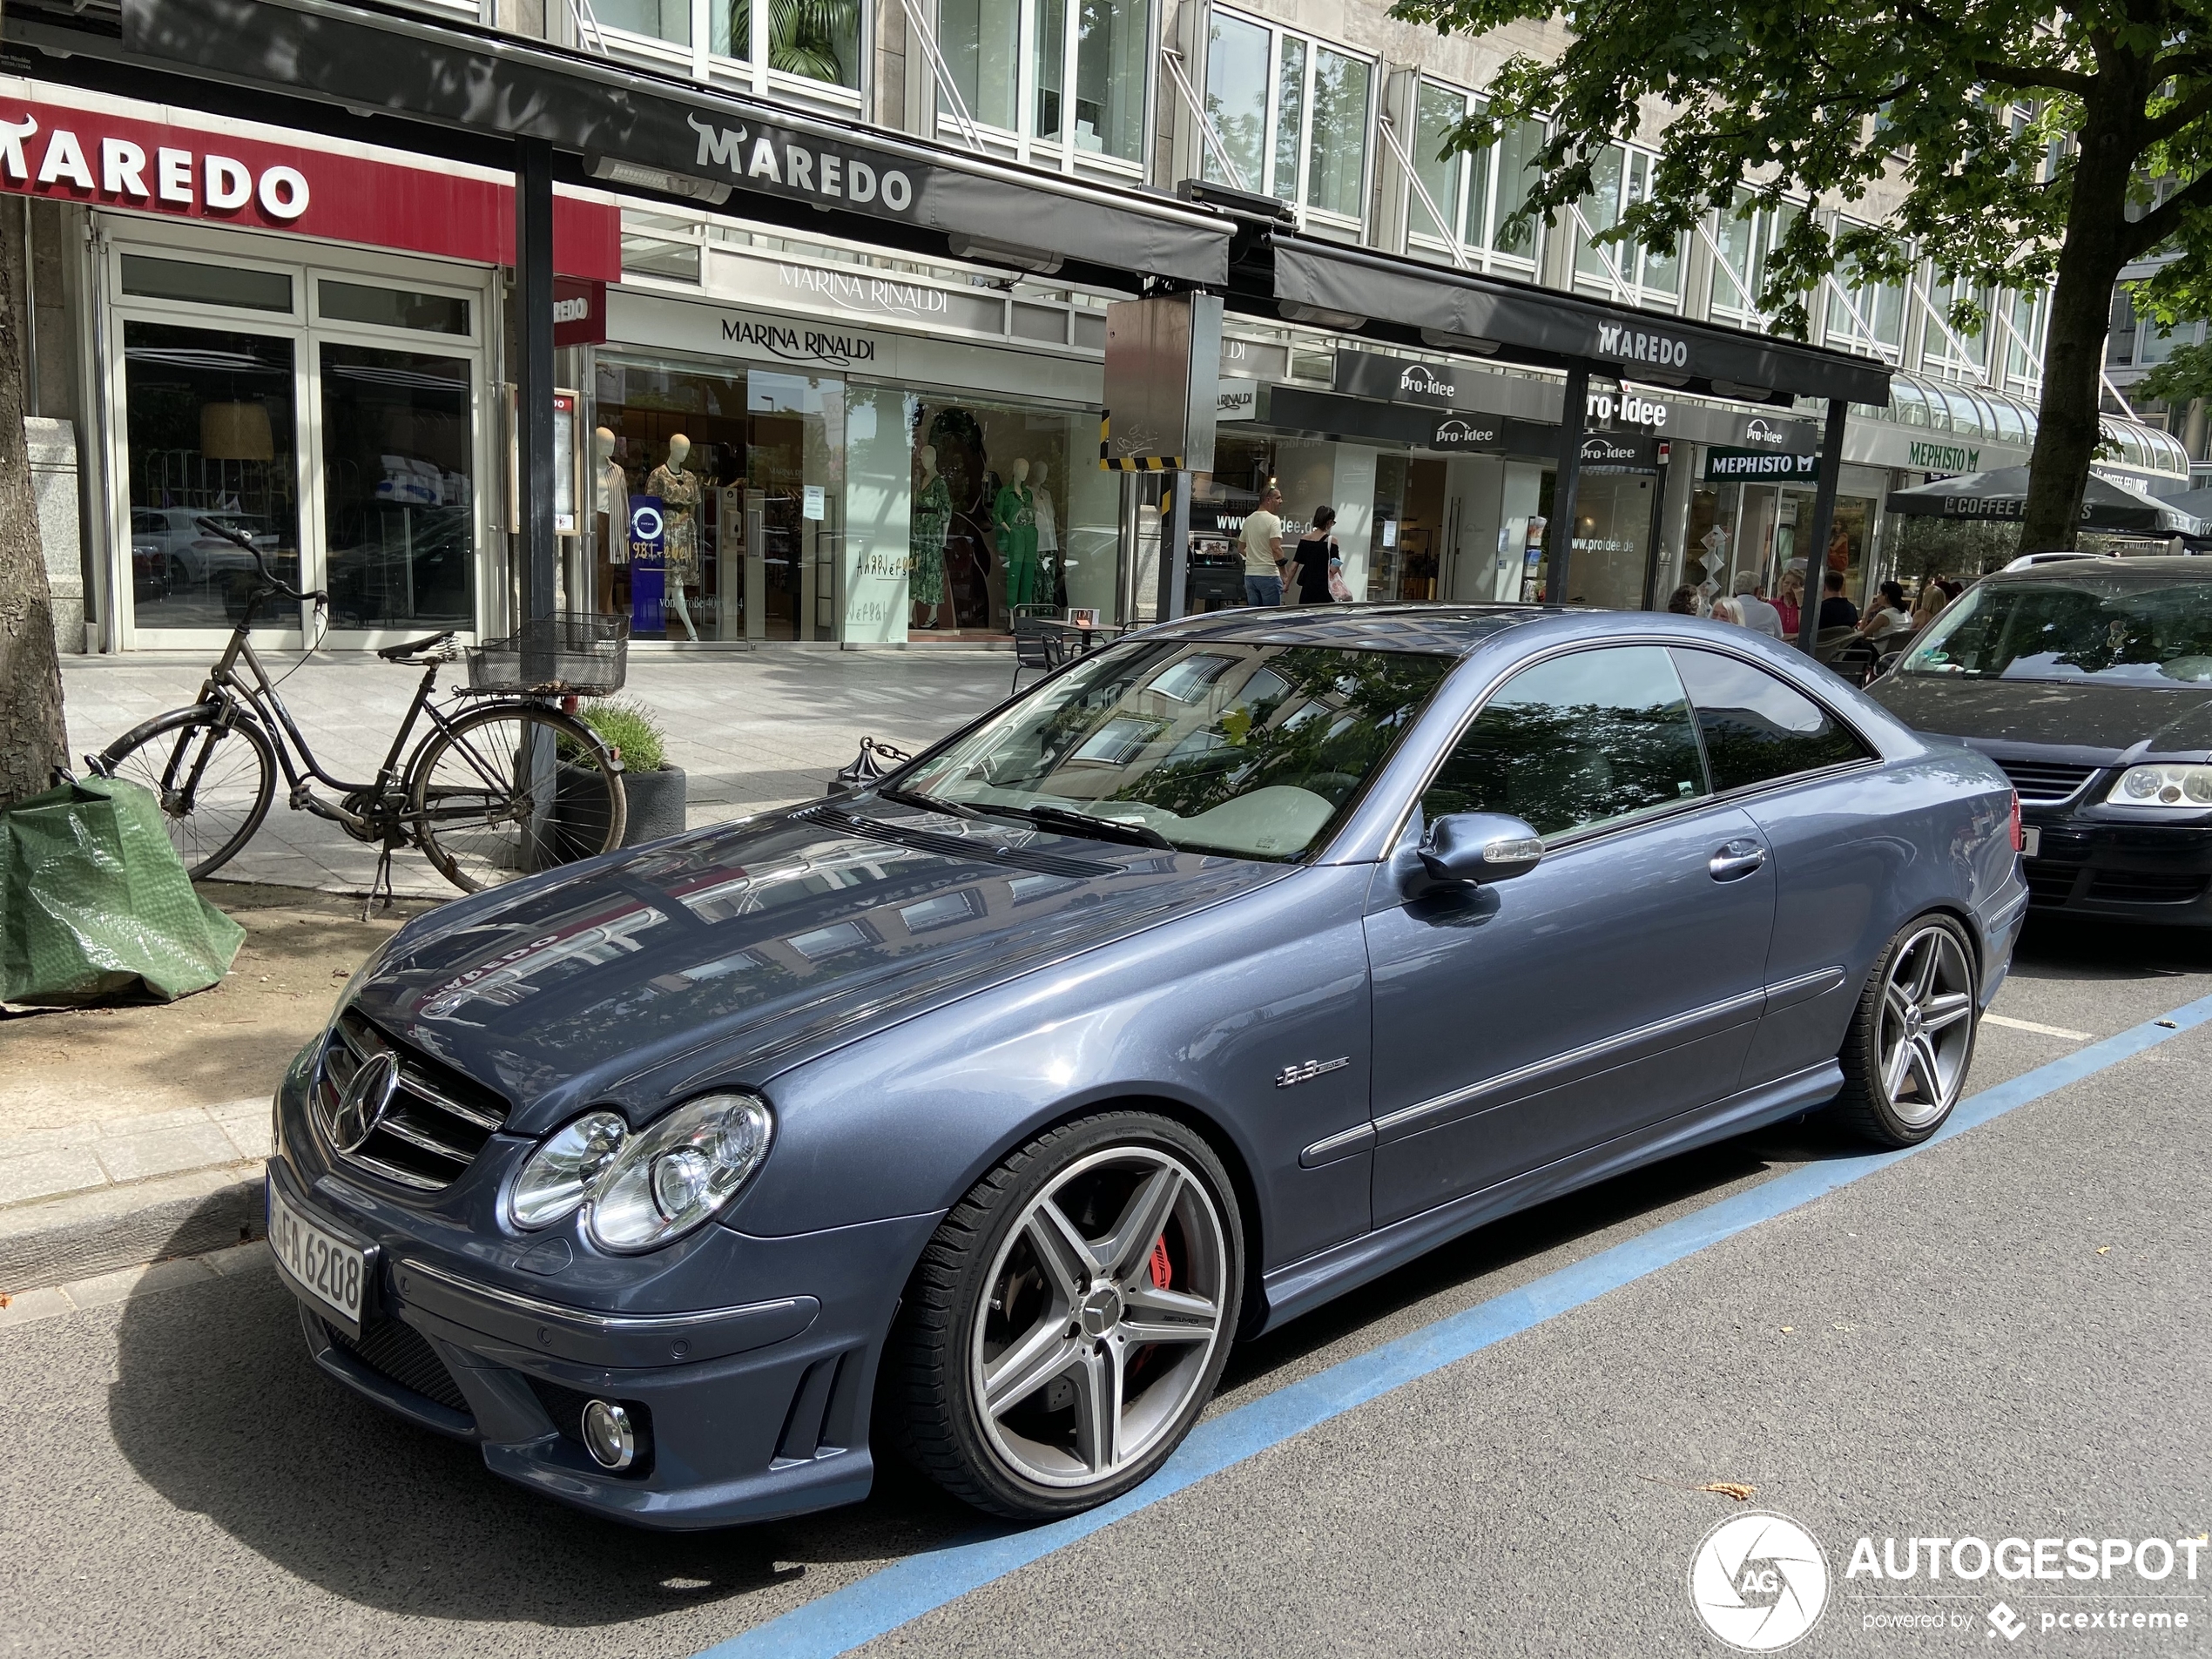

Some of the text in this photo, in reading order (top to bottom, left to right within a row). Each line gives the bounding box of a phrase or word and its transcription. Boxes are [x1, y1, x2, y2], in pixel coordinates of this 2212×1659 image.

[687, 111, 912, 212] MAREDO
[779, 263, 948, 319] MARINA RINALDI
[721, 319, 874, 366] MARINA RINALDI
[1598, 320, 1688, 368] MAREDO
[1712, 455, 1792, 474] MEPHISTO
[1908, 442, 1966, 471] MEPHISTO
[1957, 498, 2016, 516] COFFEE
[305, 1233, 360, 1310] 6208
